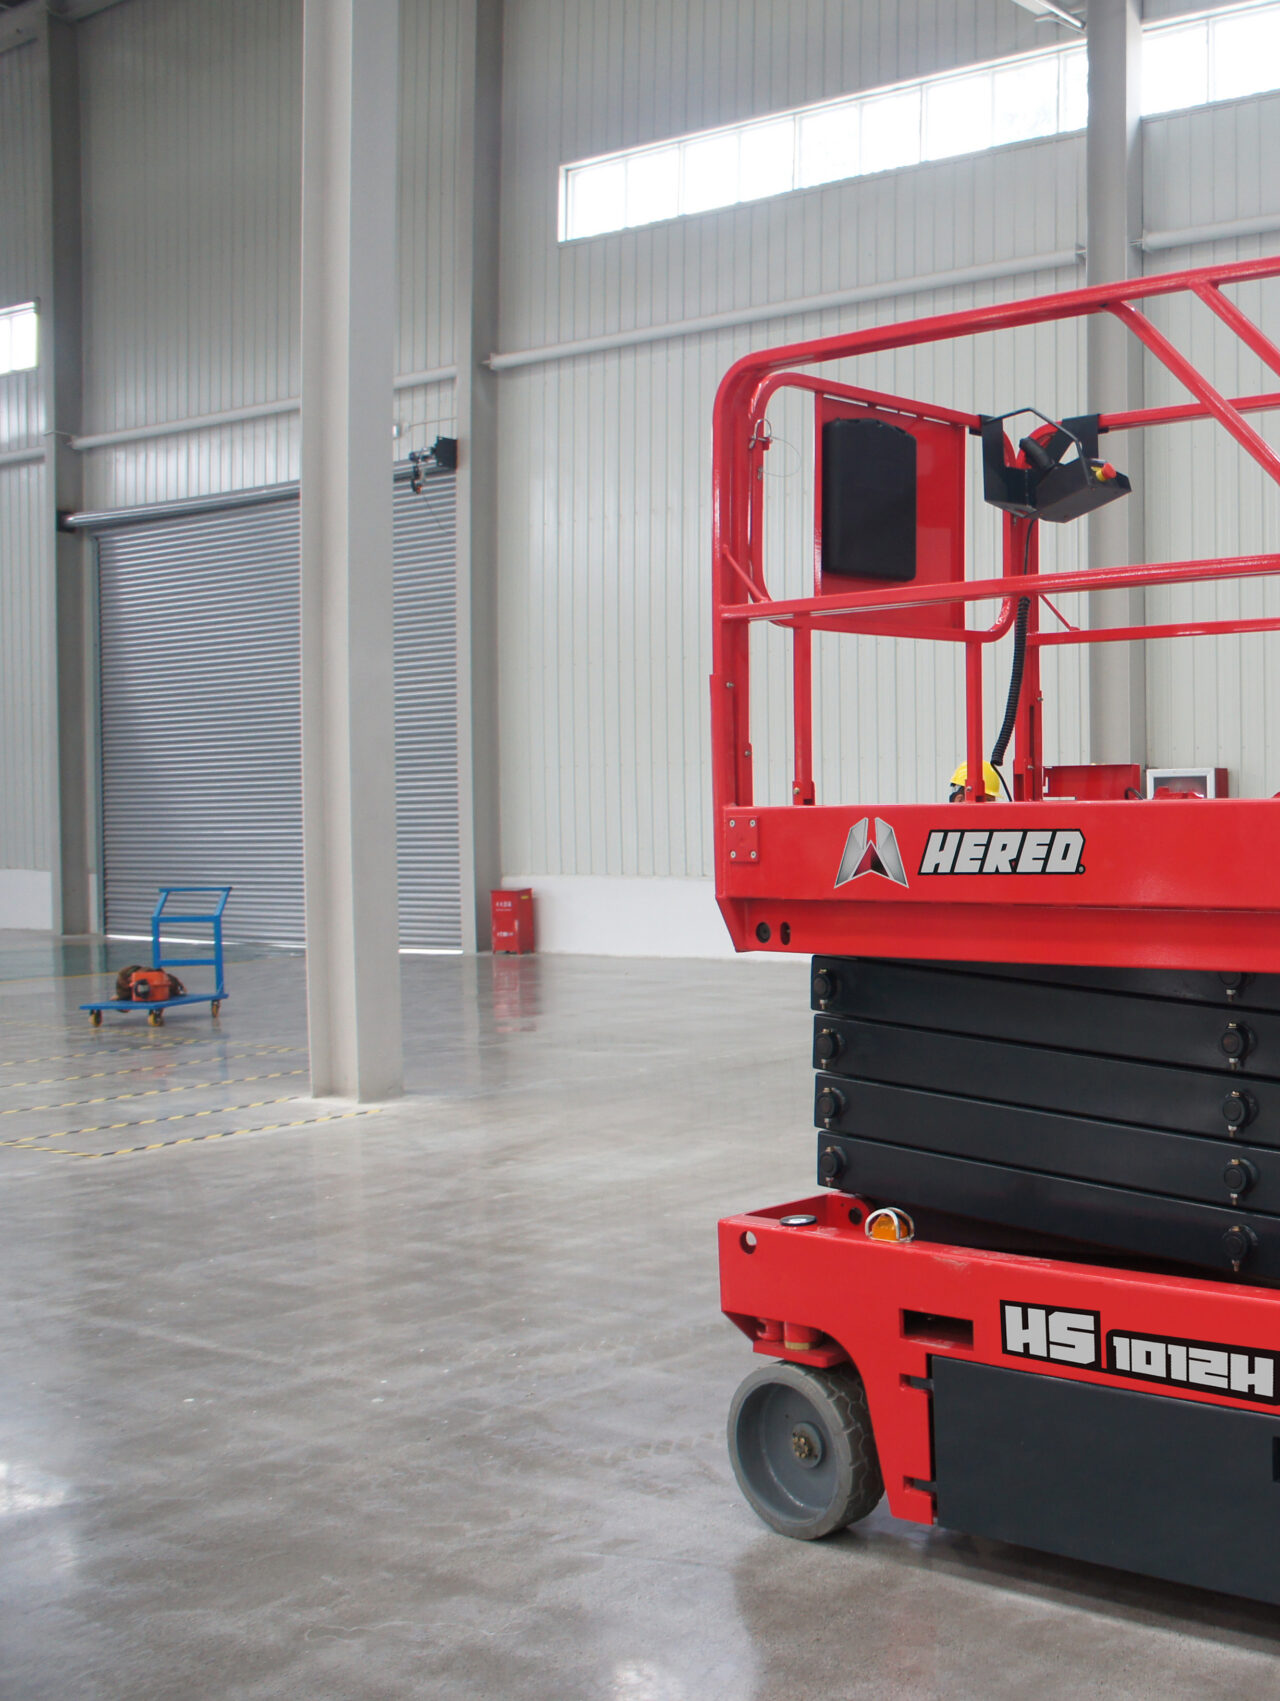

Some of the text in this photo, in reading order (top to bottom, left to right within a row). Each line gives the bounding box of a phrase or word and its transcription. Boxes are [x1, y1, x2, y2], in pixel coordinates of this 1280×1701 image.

[919, 830, 1085, 874] HERED
[1003, 1304, 1275, 1398] HS 1012H
